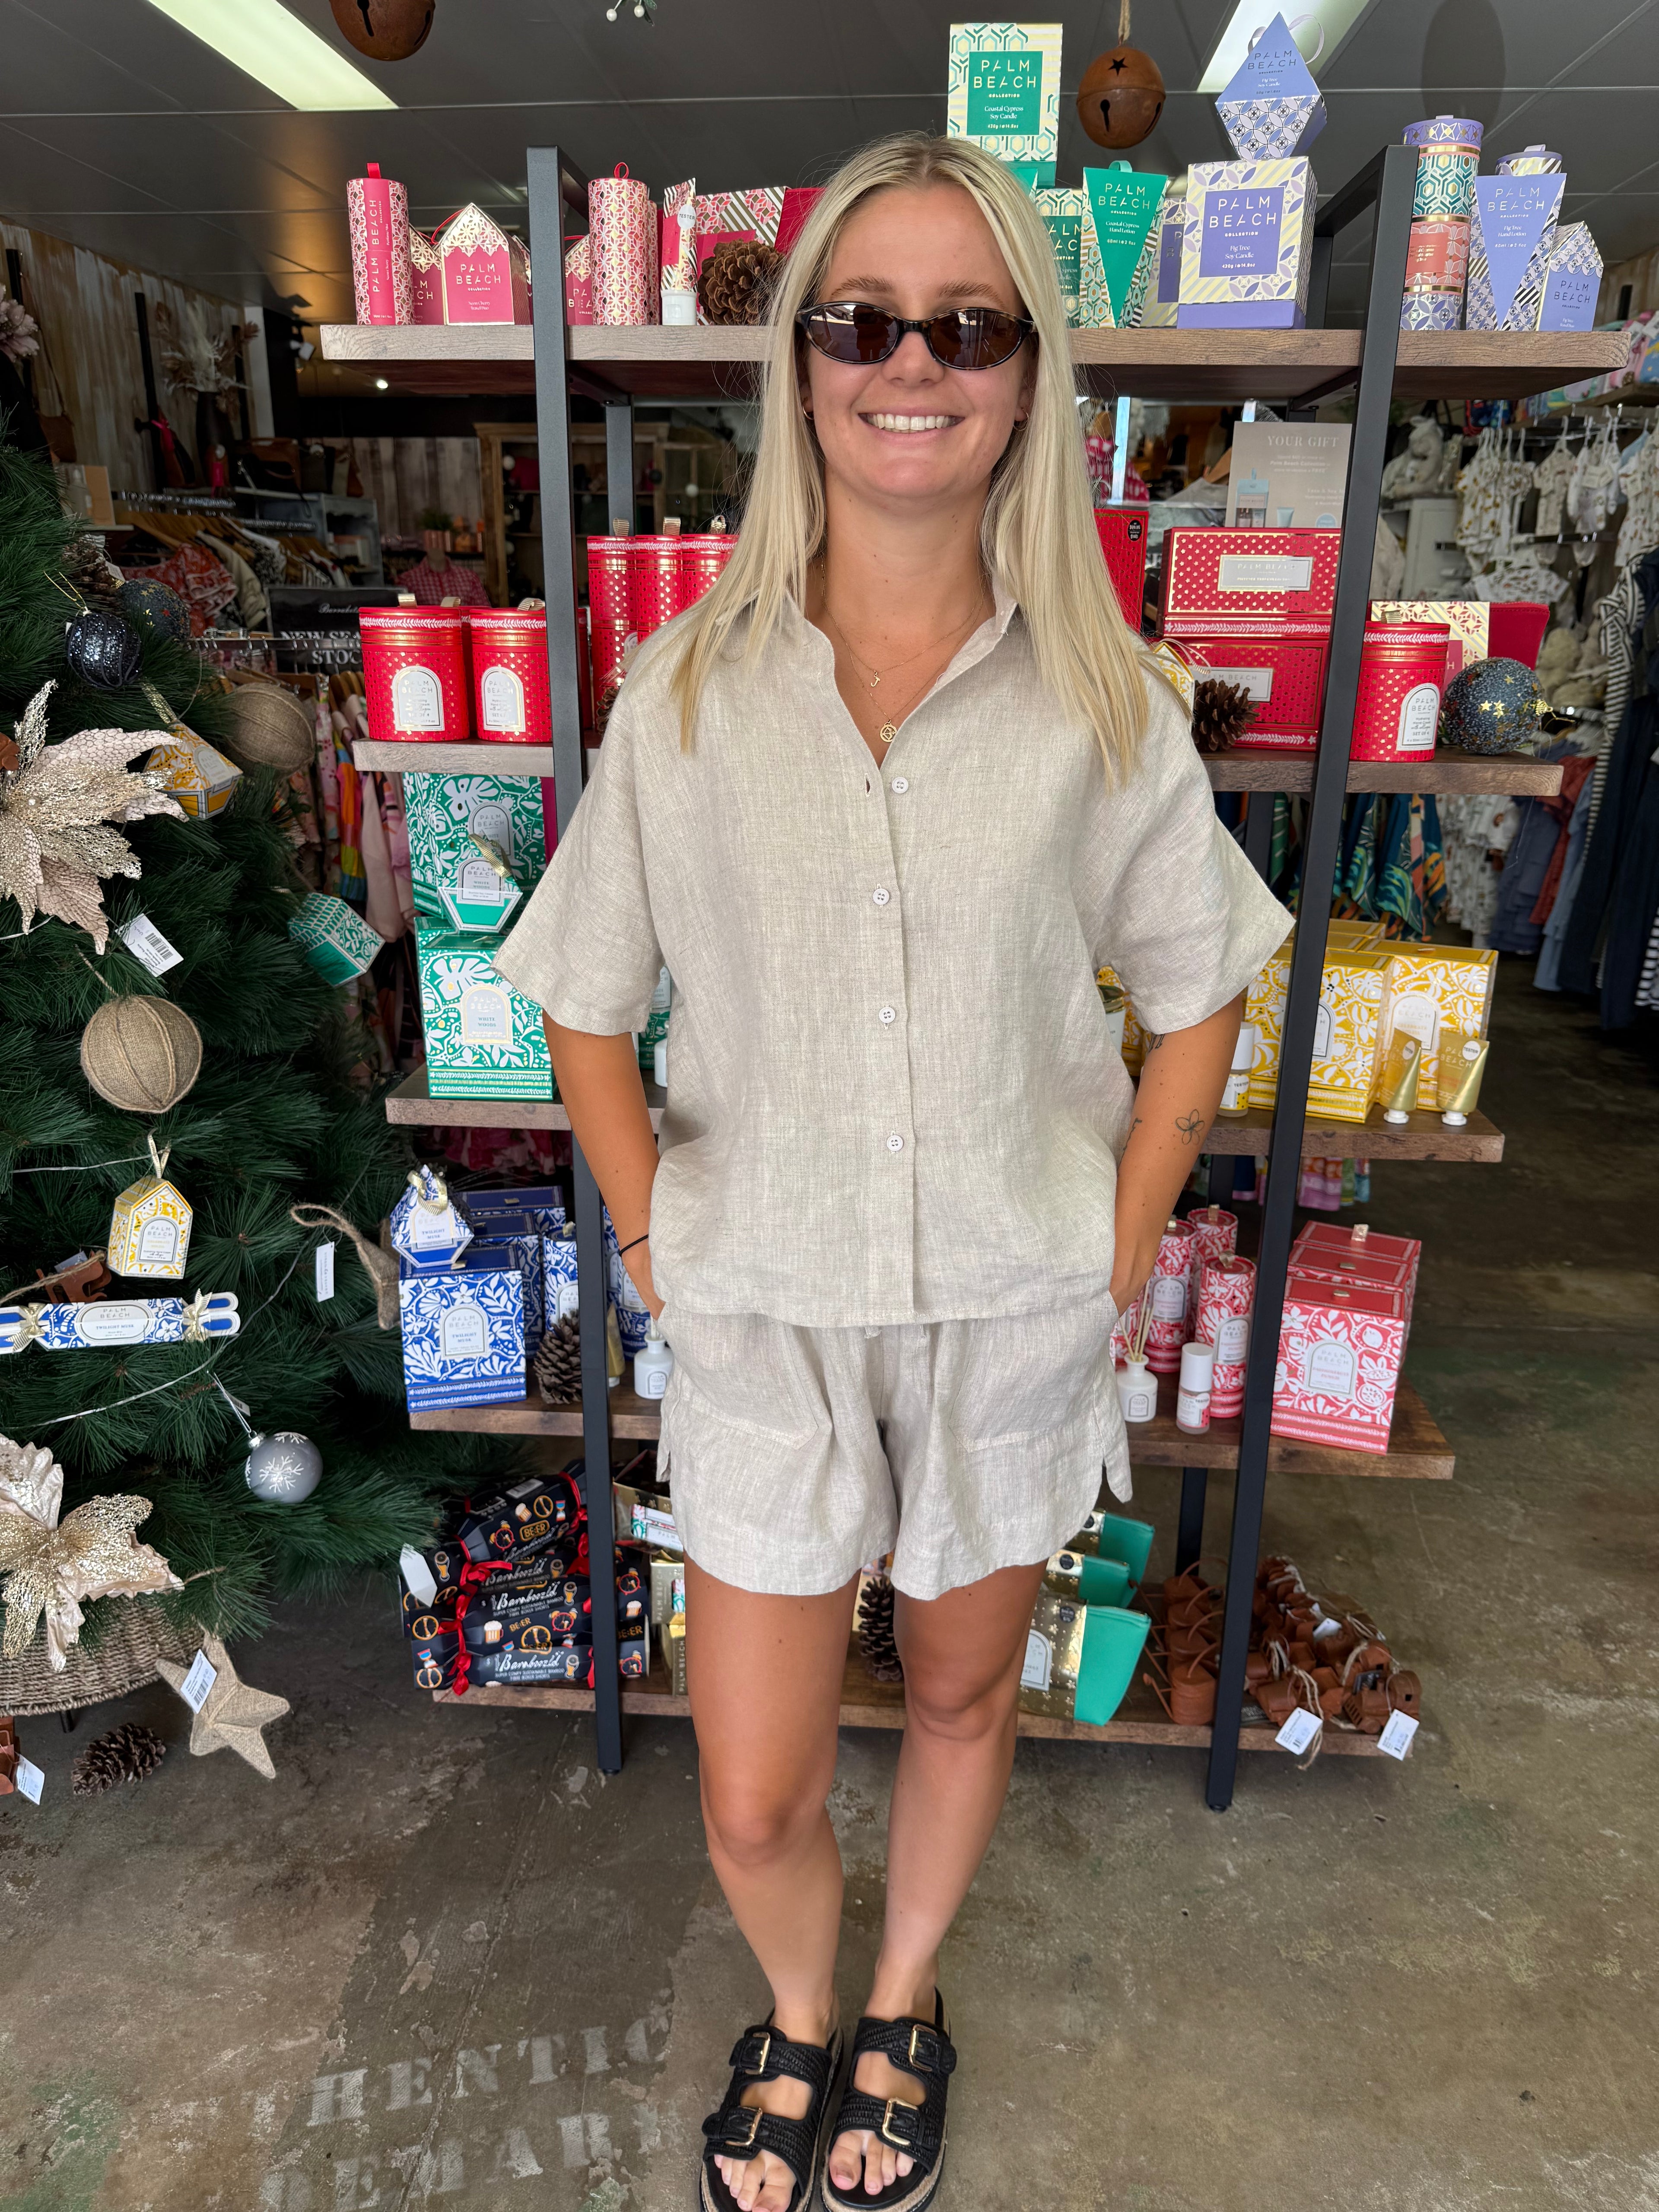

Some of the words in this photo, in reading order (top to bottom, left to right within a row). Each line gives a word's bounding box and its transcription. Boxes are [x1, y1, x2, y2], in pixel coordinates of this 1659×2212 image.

[1255, 50, 1292, 60] PALM
[981, 60, 1030, 72] PALM
[1248, 59, 1296, 70] BEACH
[973, 76, 1036, 88] BEACH
[1106, 183, 1145, 196] PALM
[1495, 188, 1540, 197] PALM
[1099, 196, 1150, 209] BEACH
[1218, 196, 1270, 210] PALM
[1487, 201, 1545, 211] BEACH
[369, 200, 379, 245] BEACH
[1209, 213, 1276, 228] BEACH
[1049, 224, 1082, 235] ALM
[461, 264, 495, 273] PALM
[371, 258, 380, 292] PALM
[456, 275, 501, 284] BEACH
[1560, 280, 1589, 291] PALM
[1554, 292, 1590, 303] BEACH
[1267, 435, 1302, 446] YOUR
[1308, 436, 1339, 447] GIFT
[1445, 1047, 1463, 1058] PAL
[1440, 1054, 1472, 1068] BEACH
